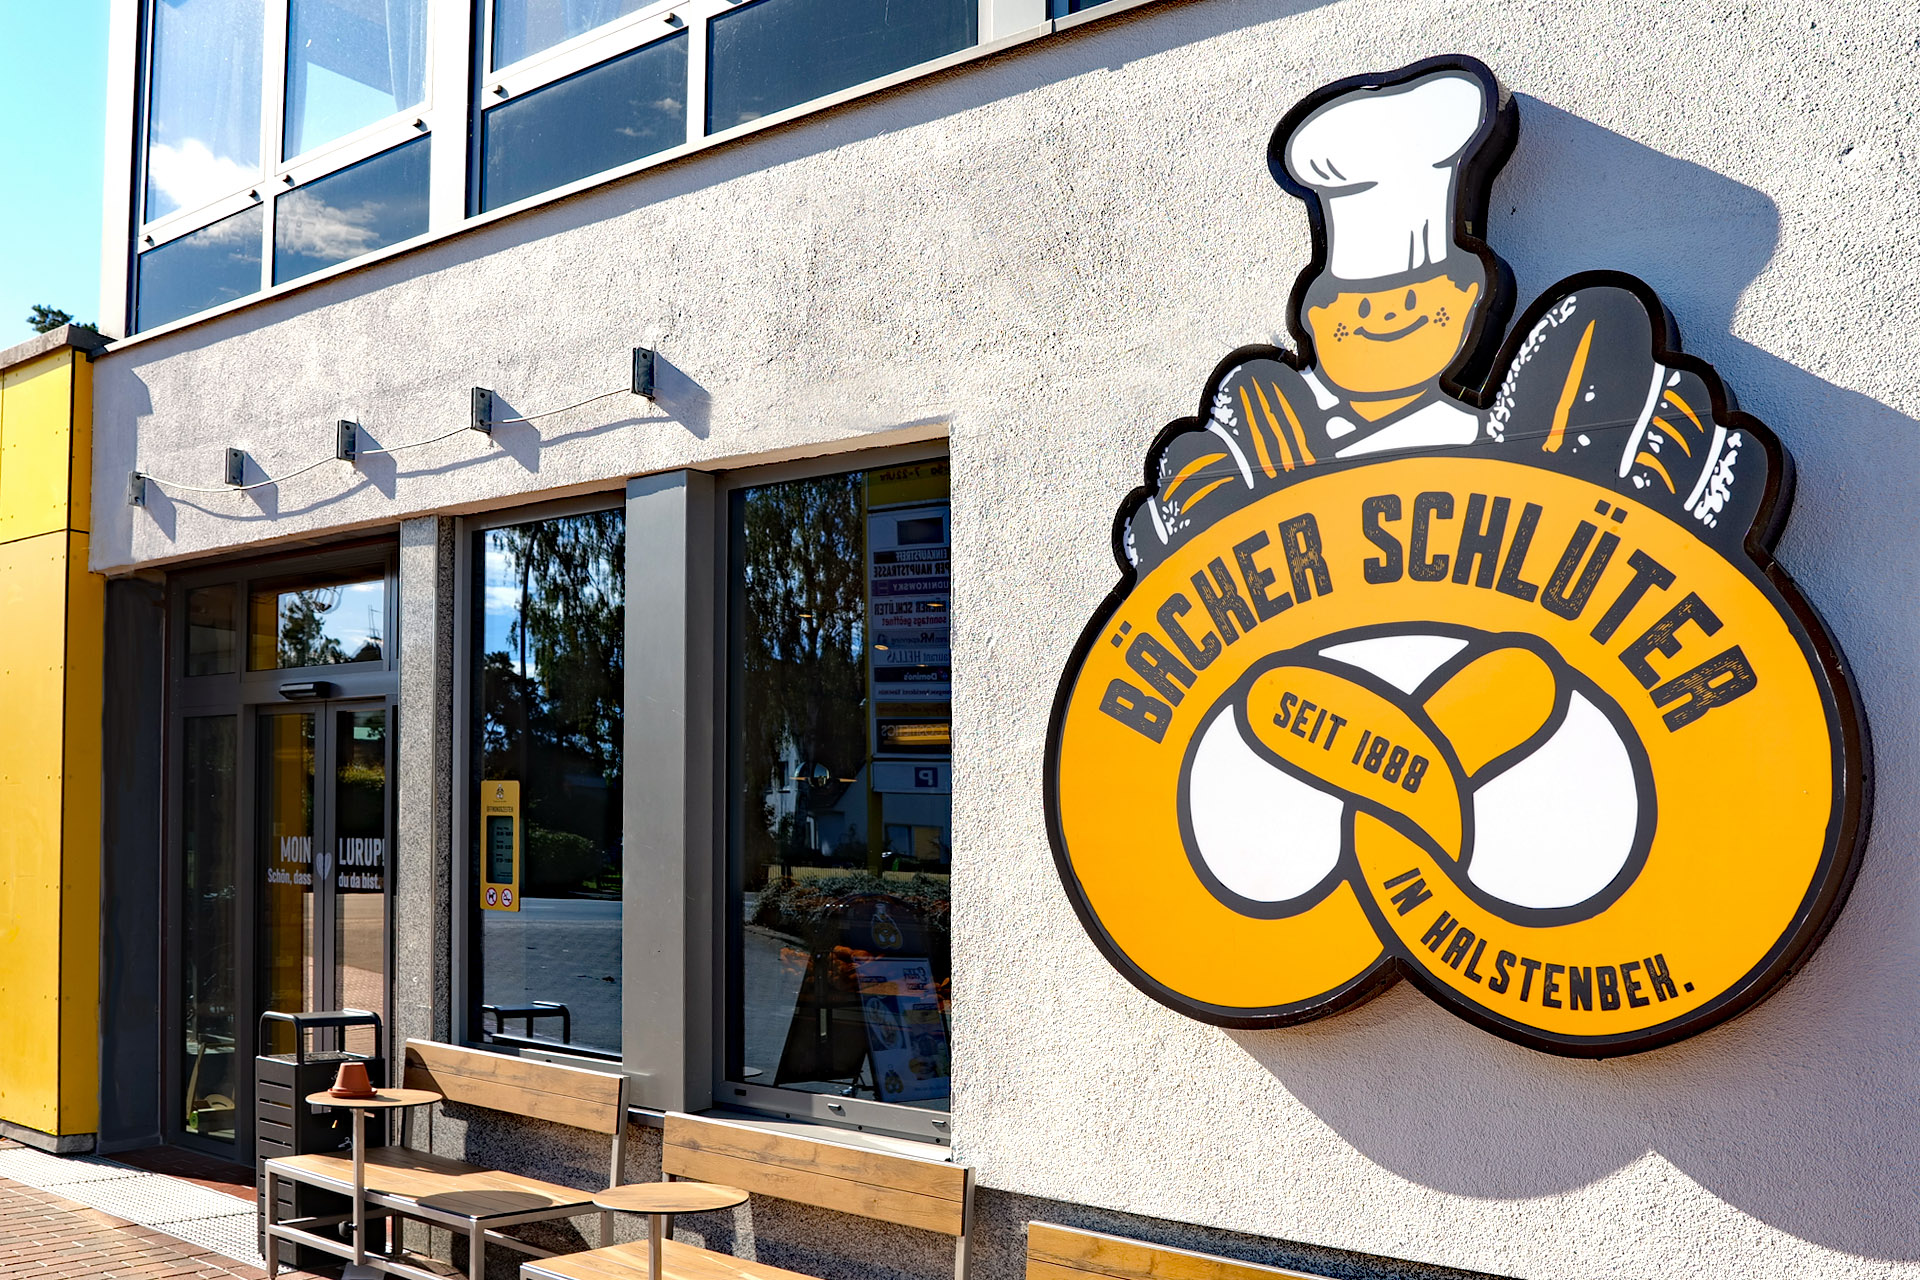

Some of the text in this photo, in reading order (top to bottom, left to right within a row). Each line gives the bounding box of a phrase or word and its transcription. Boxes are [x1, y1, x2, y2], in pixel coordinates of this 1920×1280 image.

[1099, 490, 1760, 744] BÄCKER SCHLÜTER
[1273, 691, 1431, 794] SEIT 1888
[267, 867, 381, 889] Schön, dass du da bist.
[281, 836, 384, 867] MOIN LURUP!
[1384, 868, 1696, 1012] IN HALSTENBEK.
